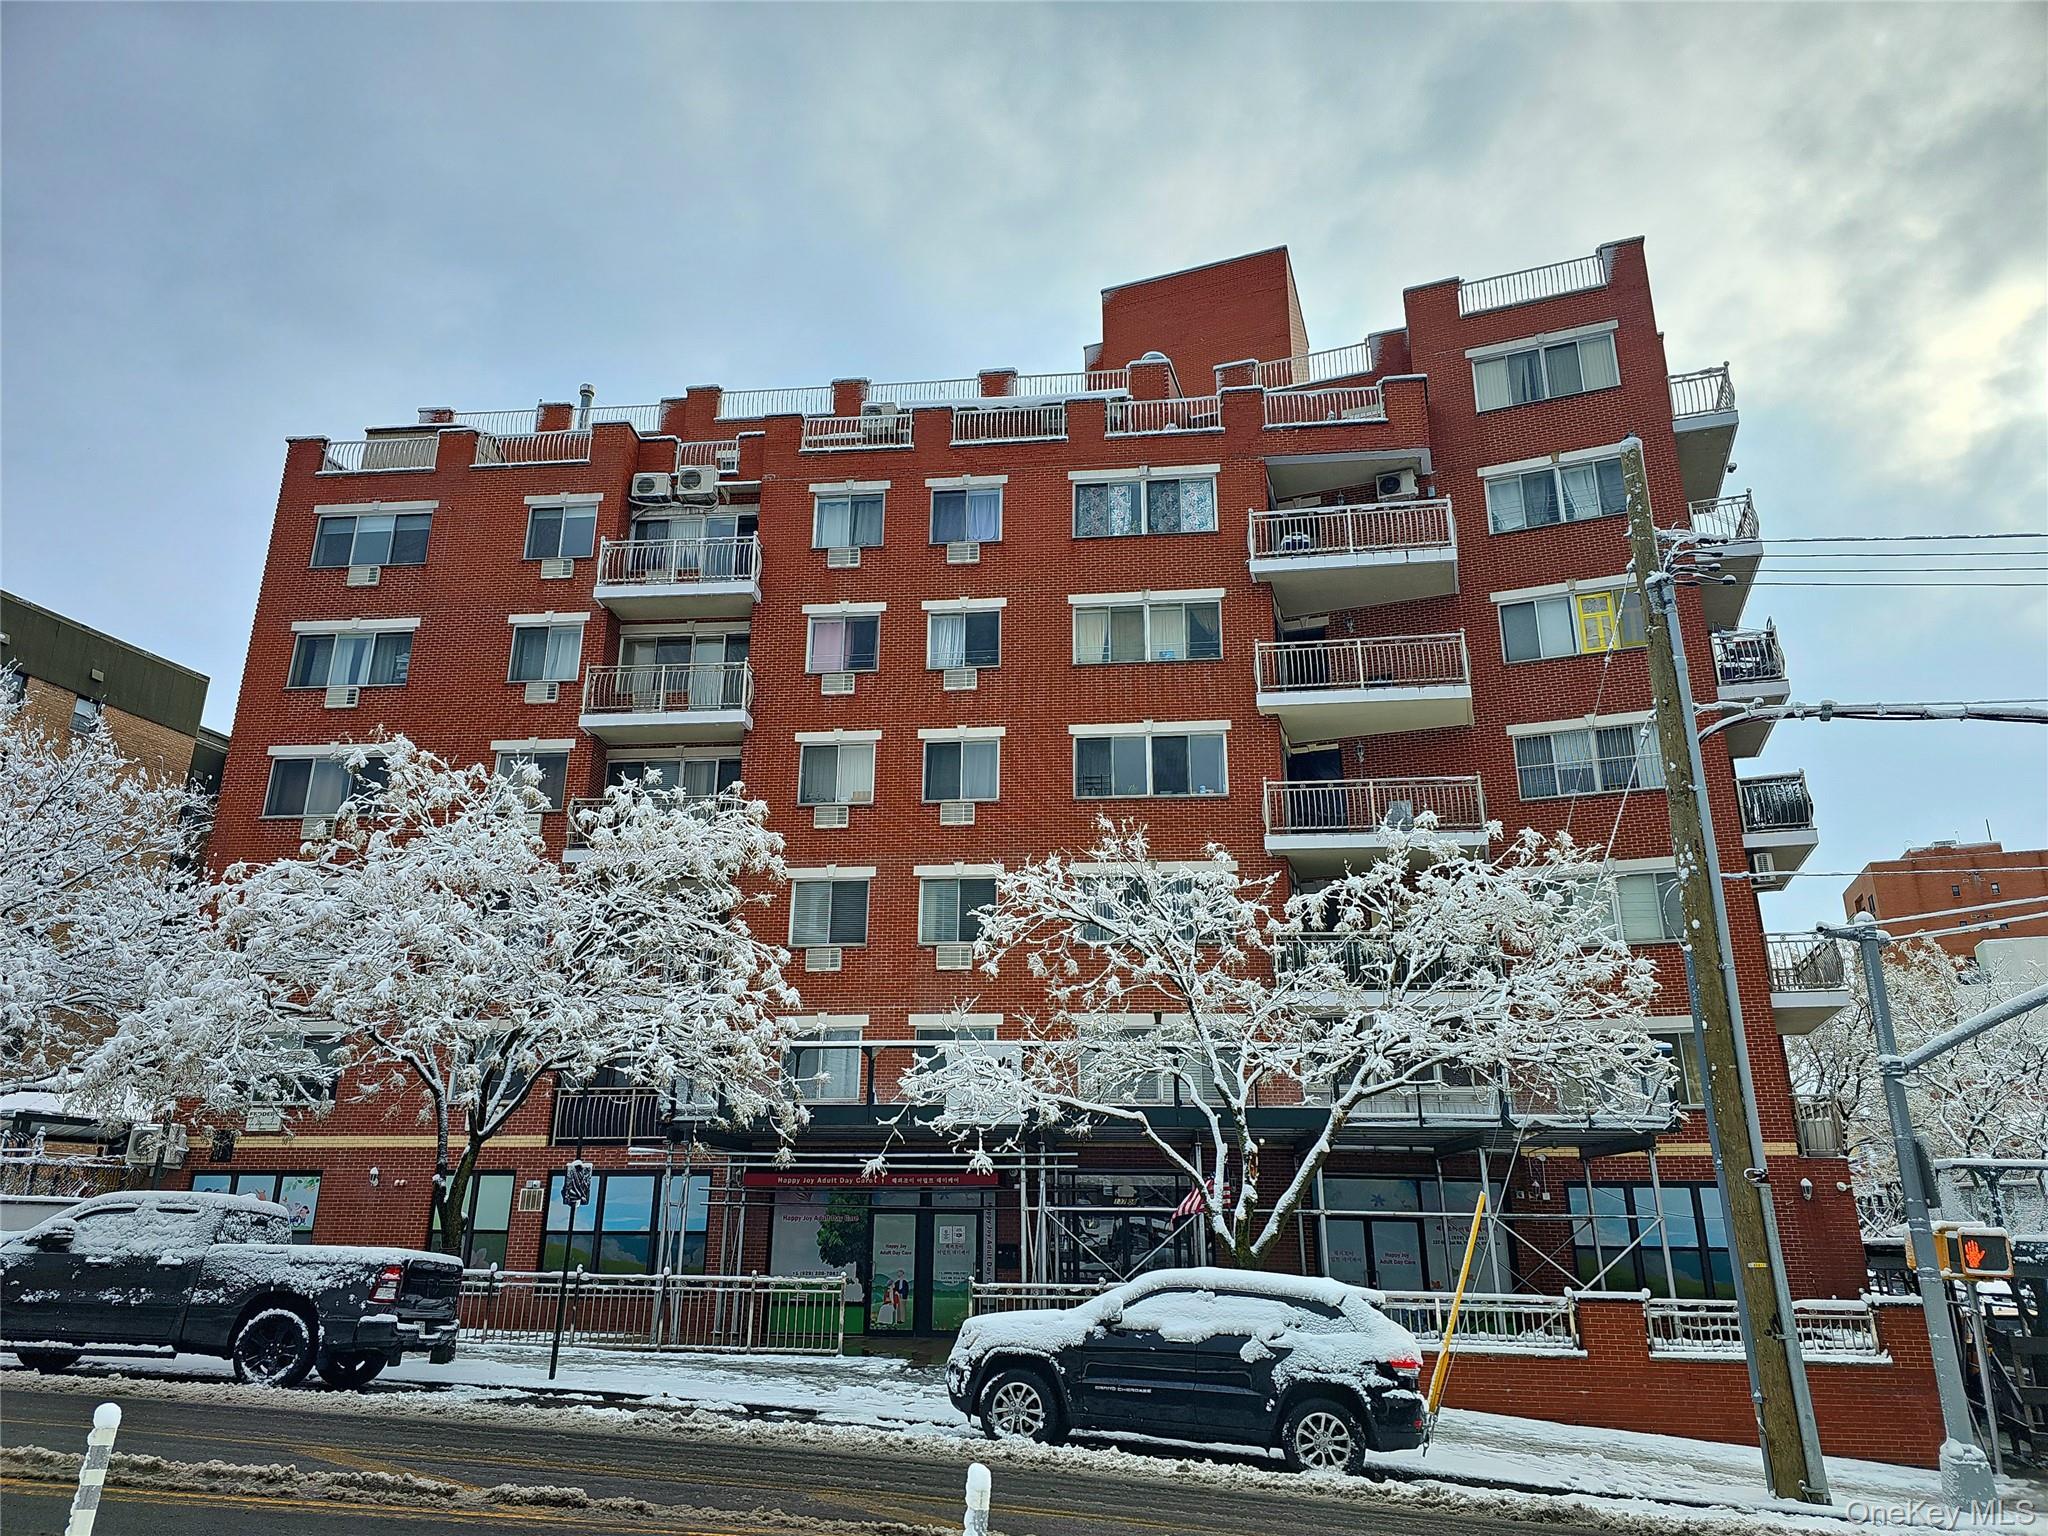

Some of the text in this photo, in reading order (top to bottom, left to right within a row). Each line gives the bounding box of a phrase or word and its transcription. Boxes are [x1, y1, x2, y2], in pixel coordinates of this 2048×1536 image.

[777, 1176, 873, 1185] Happy Joy Adult Day Care
[782, 1215, 802, 1223] Happy
[802, 1215, 813, 1223] Joy
[984, 1202, 993, 1224] Happy
[984, 1225, 993, 1237] Joy
[984, 1261, 993, 1277] Day
